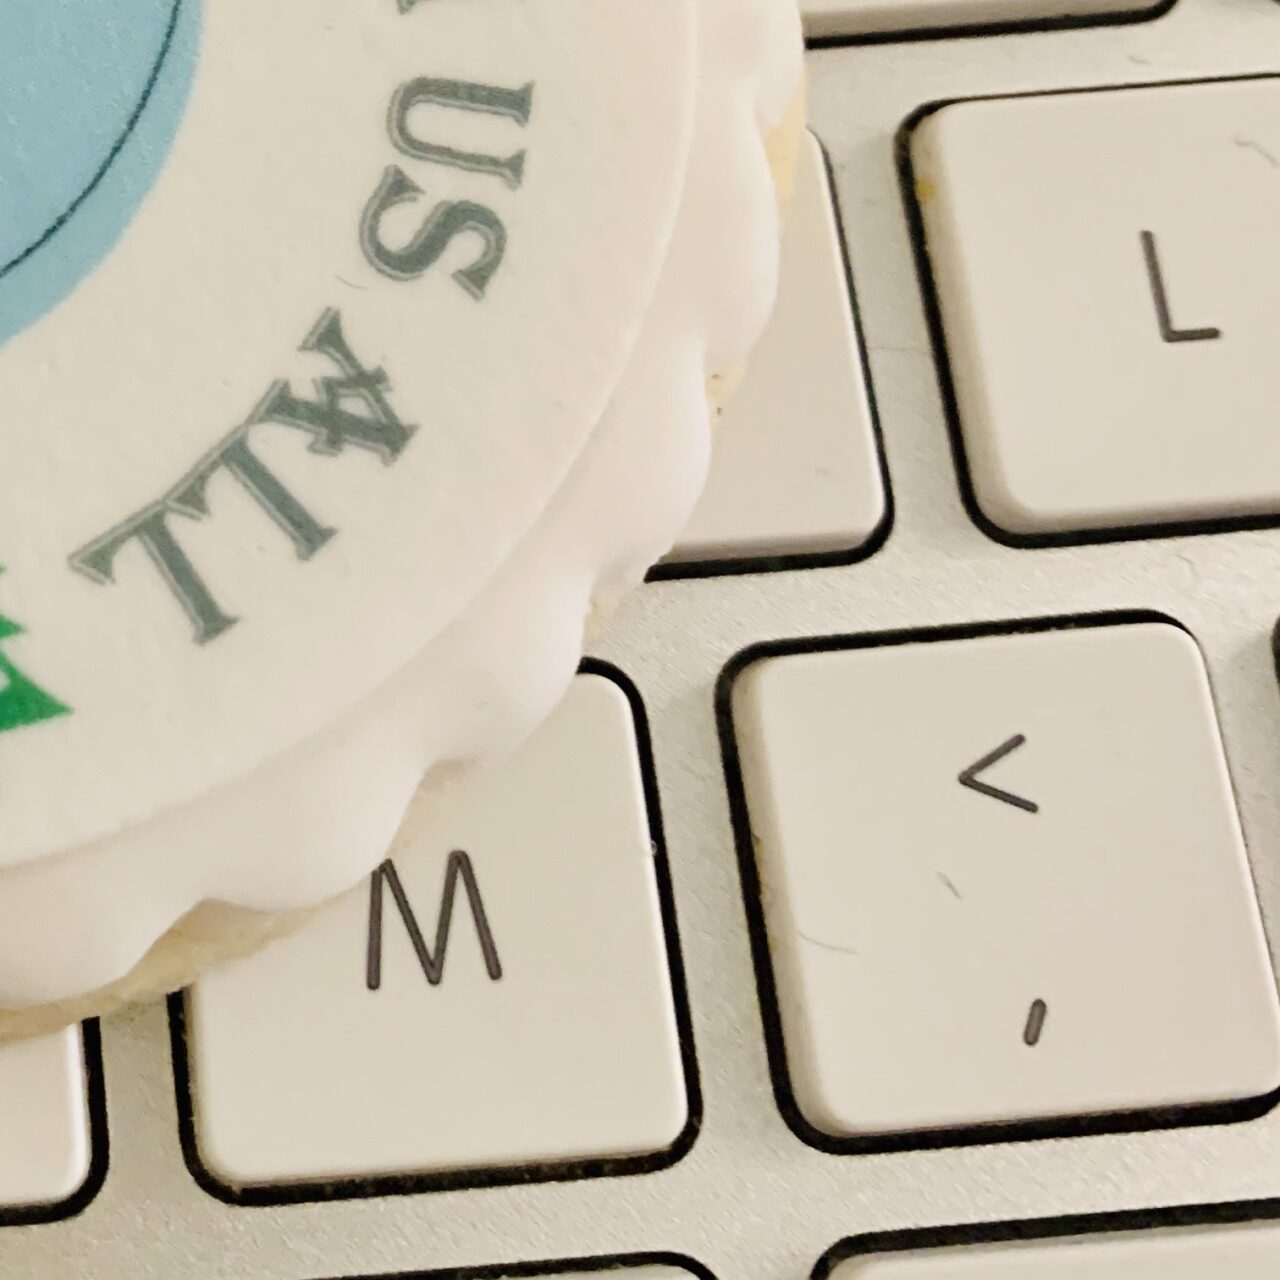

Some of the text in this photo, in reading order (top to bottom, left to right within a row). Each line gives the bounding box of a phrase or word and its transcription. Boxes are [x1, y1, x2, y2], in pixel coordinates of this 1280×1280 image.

[357, 74, 536, 302] US
[1139, 229, 1223, 345] L
[67, 306, 419, 647] ALL
[365, 848, 503, 993] M
